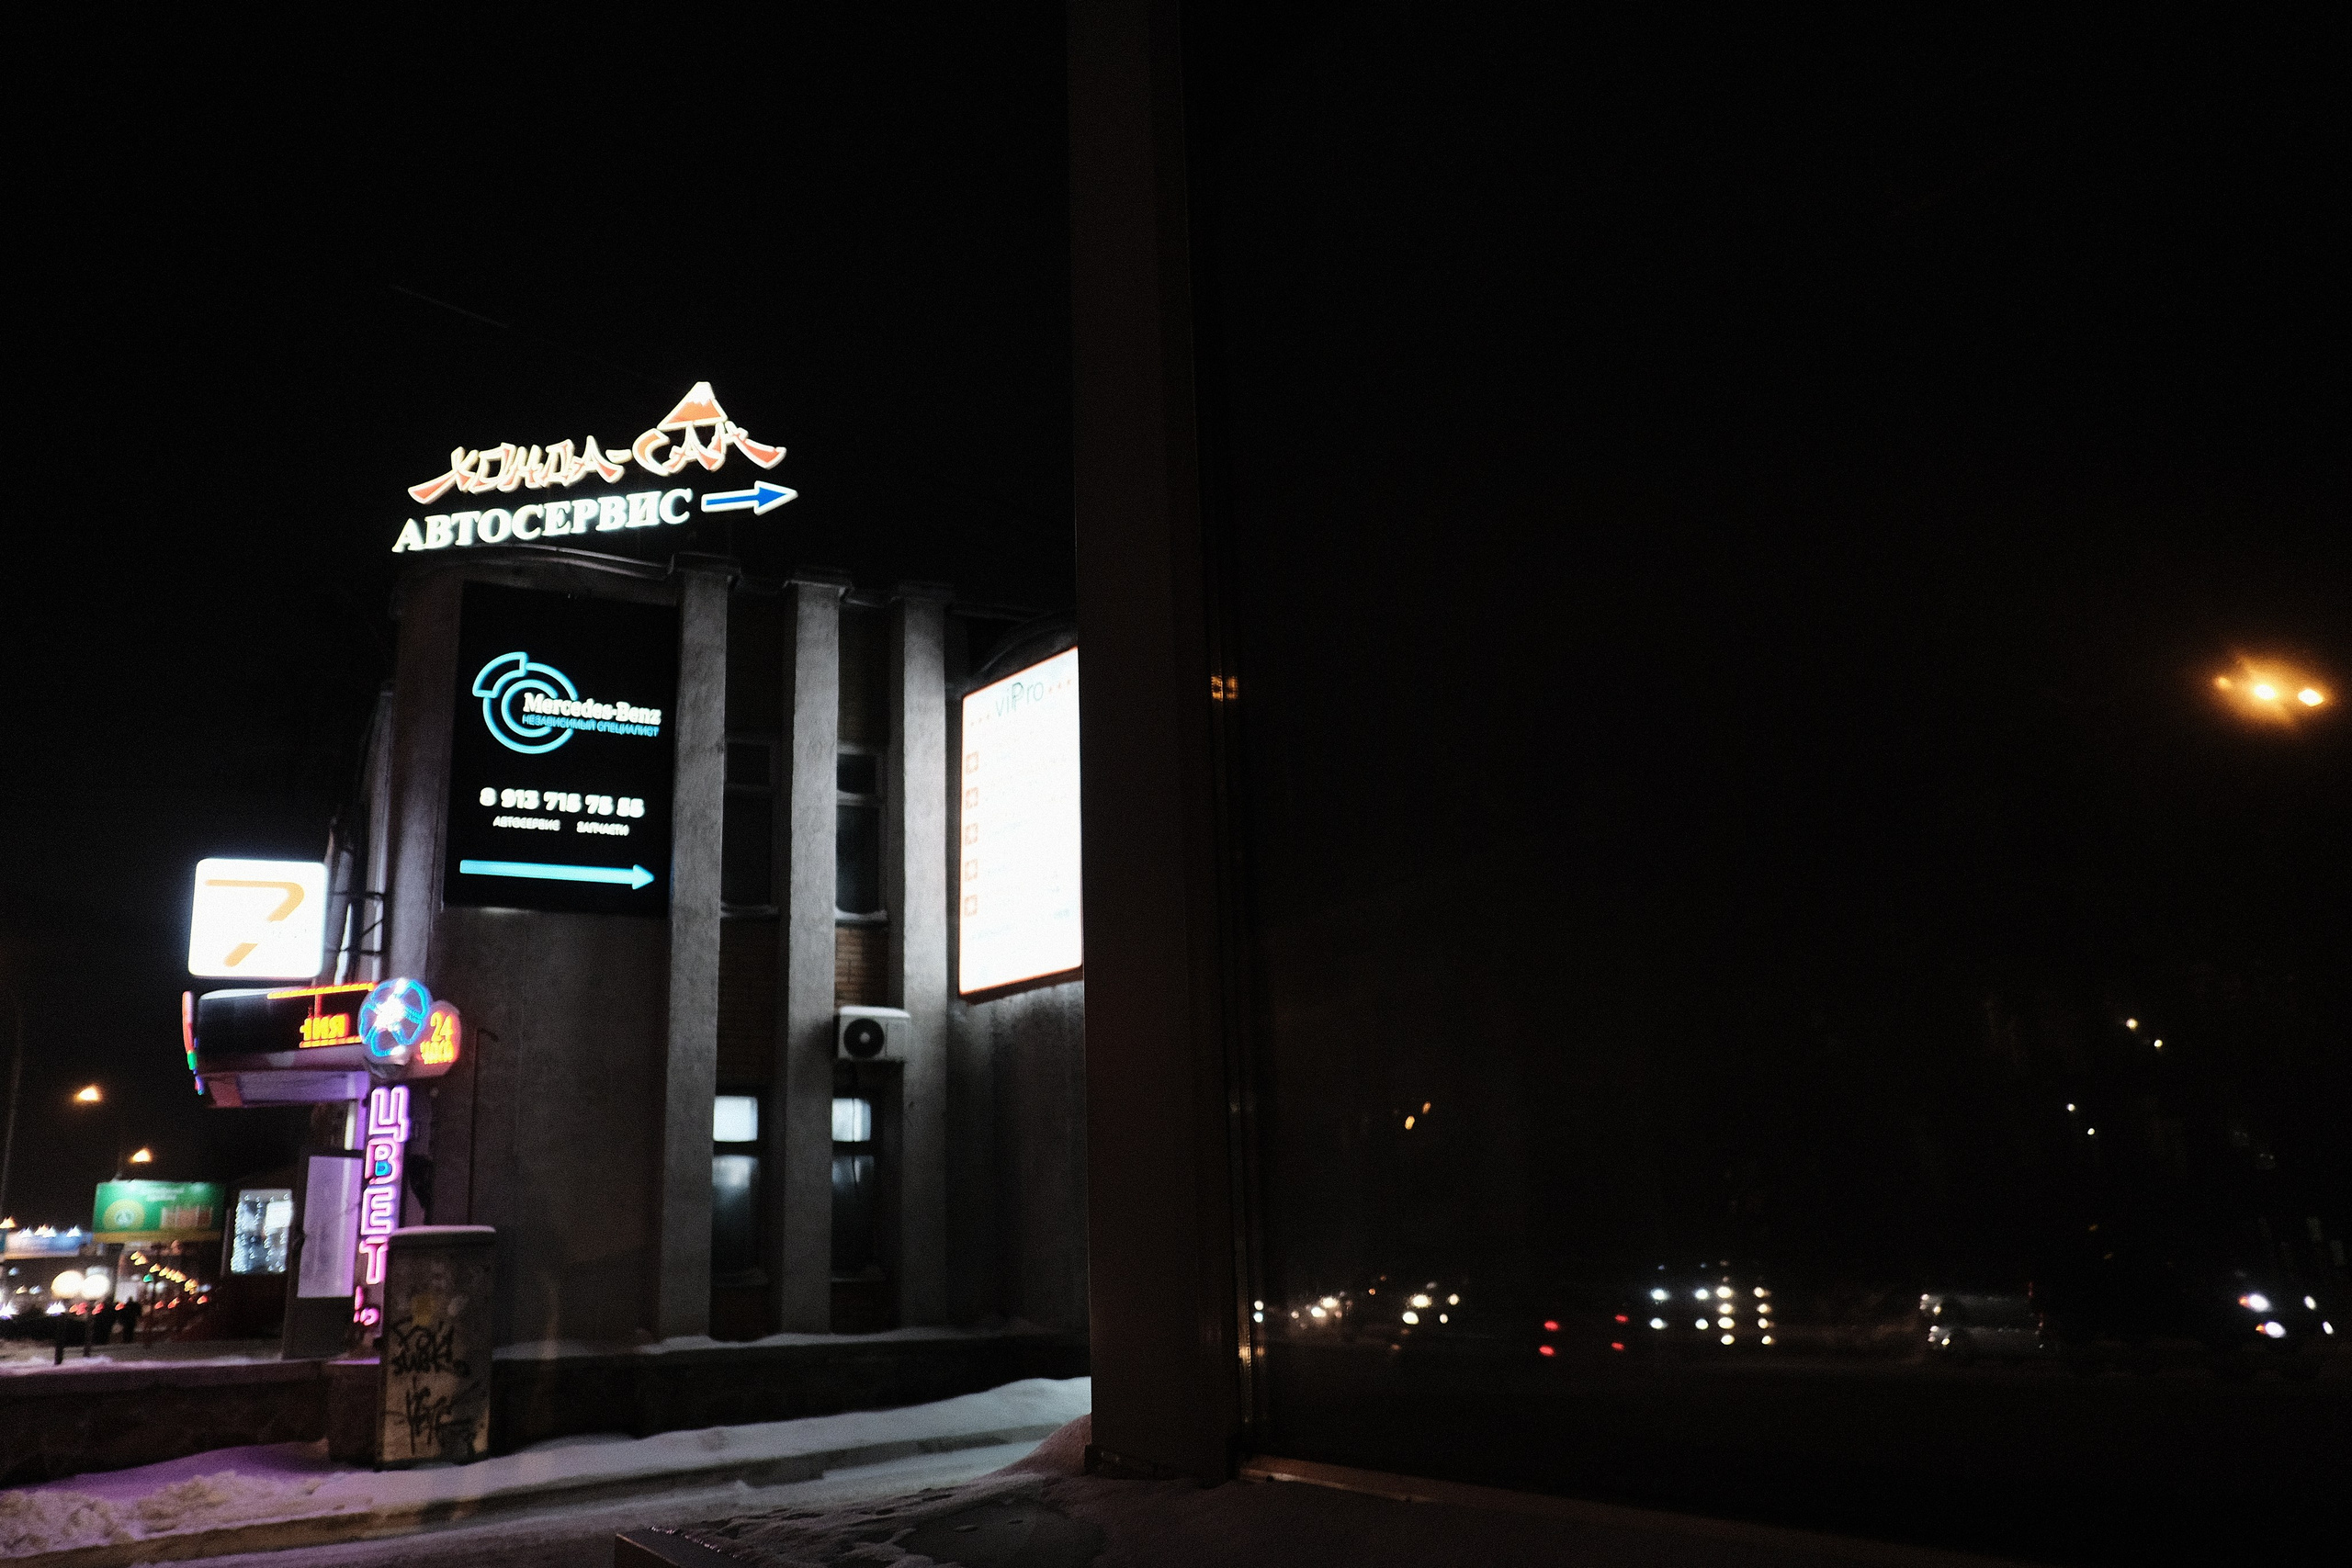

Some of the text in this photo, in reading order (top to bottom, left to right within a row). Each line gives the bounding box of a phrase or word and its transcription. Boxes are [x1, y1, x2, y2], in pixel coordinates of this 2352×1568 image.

[391, 488, 694, 553] АВТОСЕРВИС
[522, 714, 661, 738] НЕЗАВИСИМЫЙ СПЕЦИАЛИСТ
[523, 692, 662, 726] Mercedes-Benz
